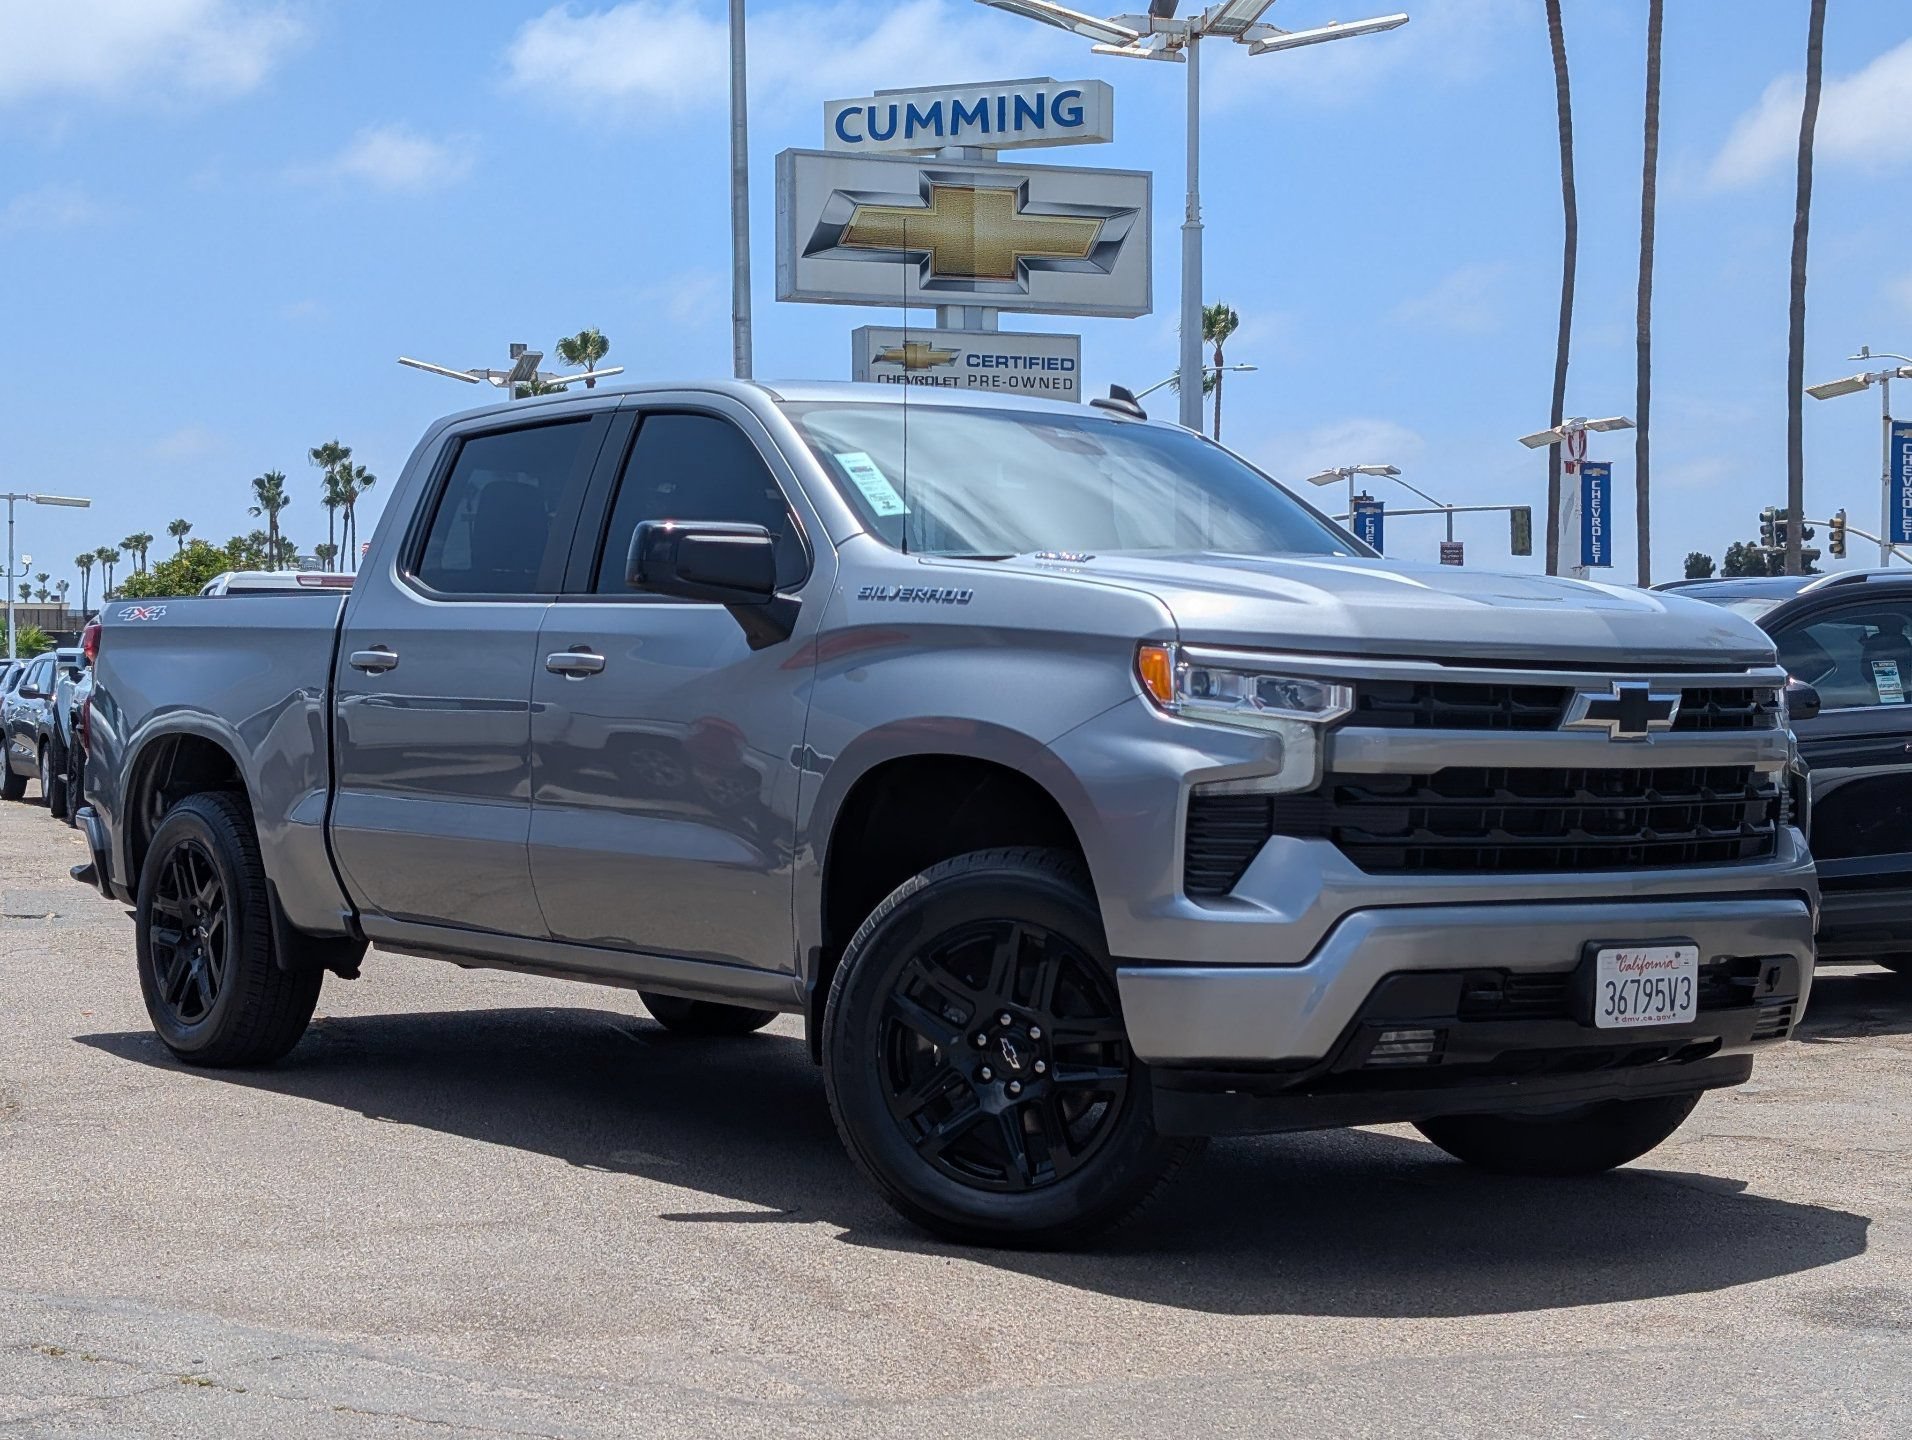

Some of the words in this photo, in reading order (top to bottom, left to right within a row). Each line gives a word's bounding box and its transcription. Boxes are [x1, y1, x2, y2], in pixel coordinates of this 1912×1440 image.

[834, 89, 1085, 143] CUMMING
[966, 353, 1075, 371] CERTIFIED
[877, 374, 960, 387] CHEVROLET
[967, 374, 1074, 390] PRE-OWNED
[1902, 443, 1912, 541] CHEVROLET
[1591, 480, 1601, 564] CHEVROLET
[857, 584, 974, 606] SILVERADO
[1619, 953, 1680, 977] California
[1604, 976, 1692, 1016] 36795V3
[1621, 1014, 1672, 1023] dmv.ca.gov
